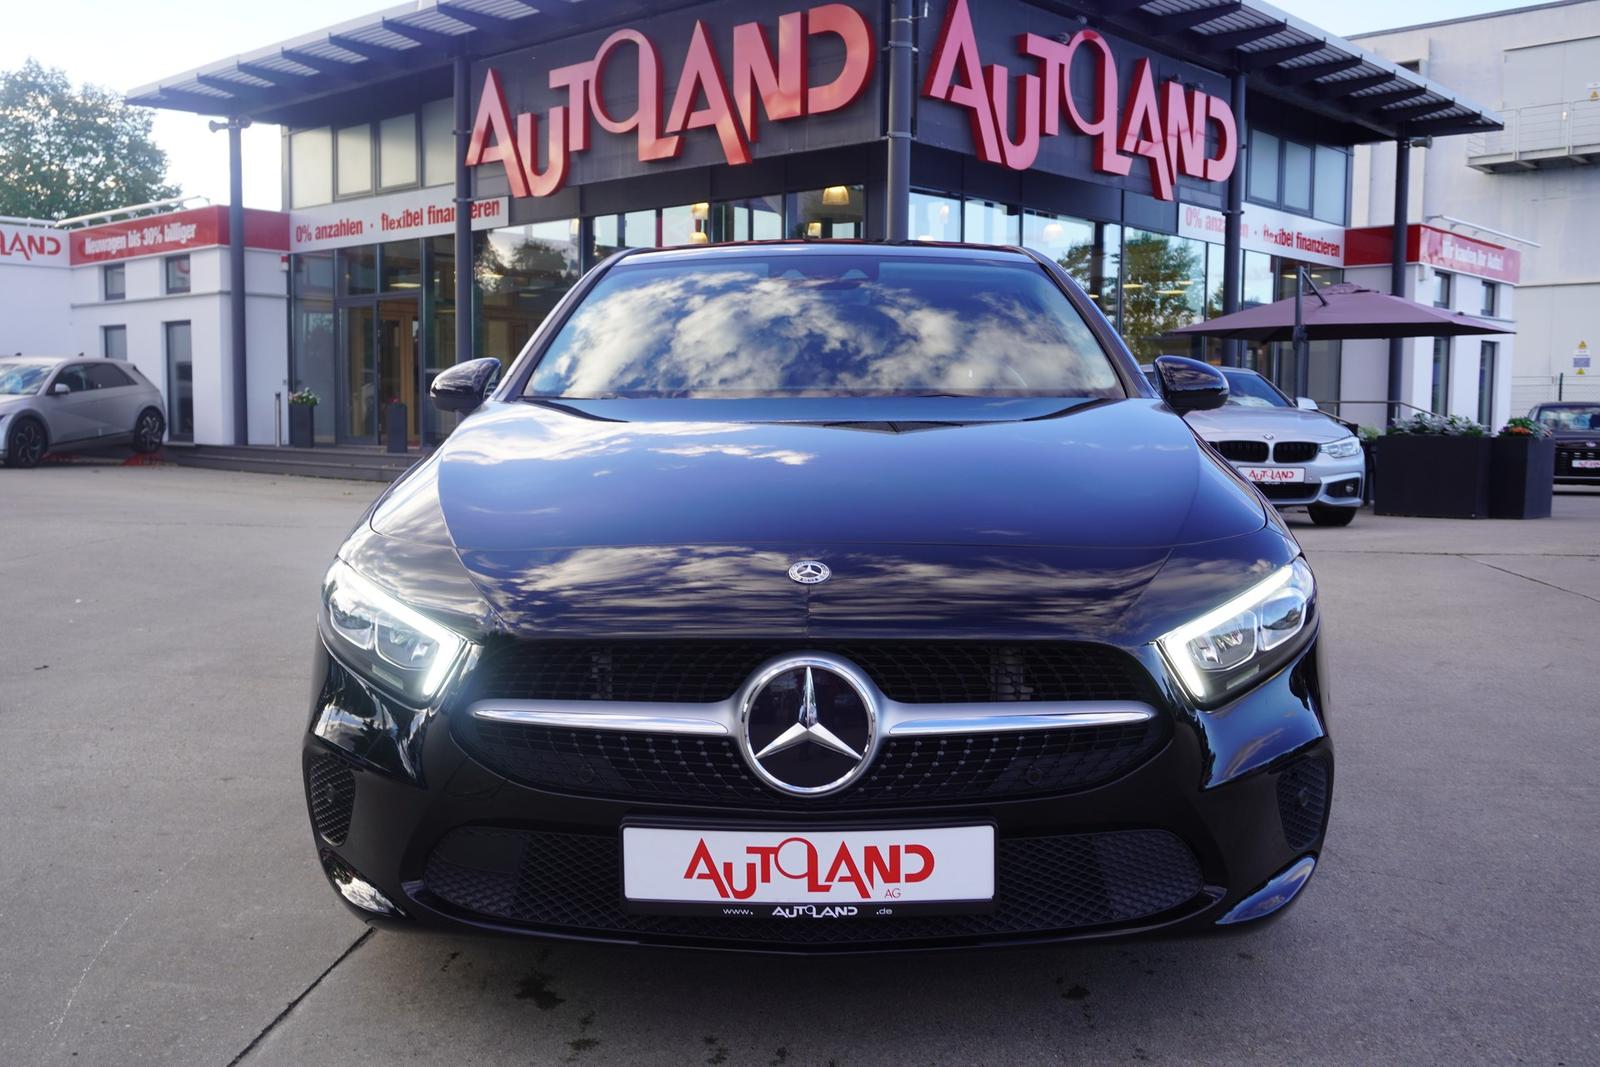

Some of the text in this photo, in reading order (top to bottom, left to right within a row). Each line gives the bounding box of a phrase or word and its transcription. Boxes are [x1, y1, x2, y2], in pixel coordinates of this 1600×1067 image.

[465, 3, 875, 198] AUTOLAND
[923, 0, 1237, 201] AUTOLAND
[296, 200, 499, 243] 0% anzahlen flexibel finaeren
[684, 837, 935, 899] AUTOLAND
[884, 887, 901, 899] AG
[722, 907, 753, 915] www.
[772, 904, 858, 918] AUTOLAND
